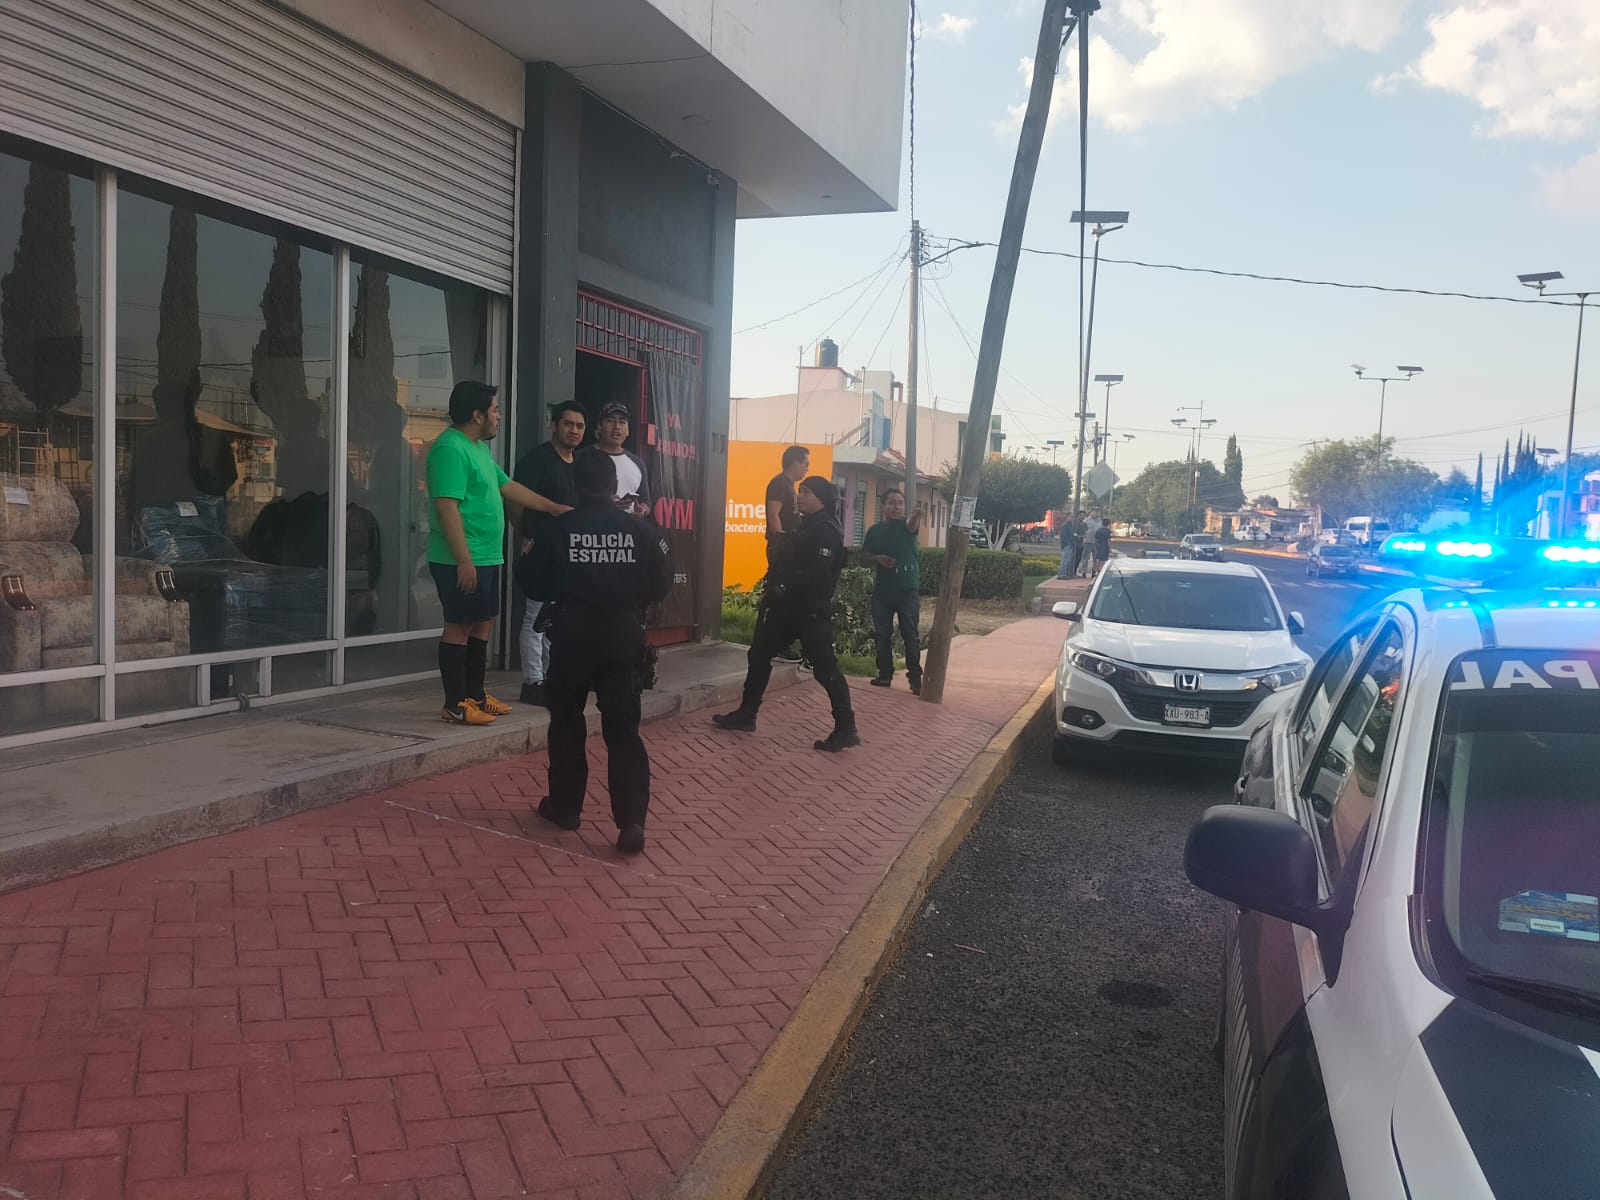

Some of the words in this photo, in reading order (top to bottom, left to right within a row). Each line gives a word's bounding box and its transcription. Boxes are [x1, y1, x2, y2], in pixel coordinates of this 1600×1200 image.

[725, 499, 767, 519] ime
[569, 532, 635, 548] POLICÍA
[568, 548, 636, 563] ESTATAL
